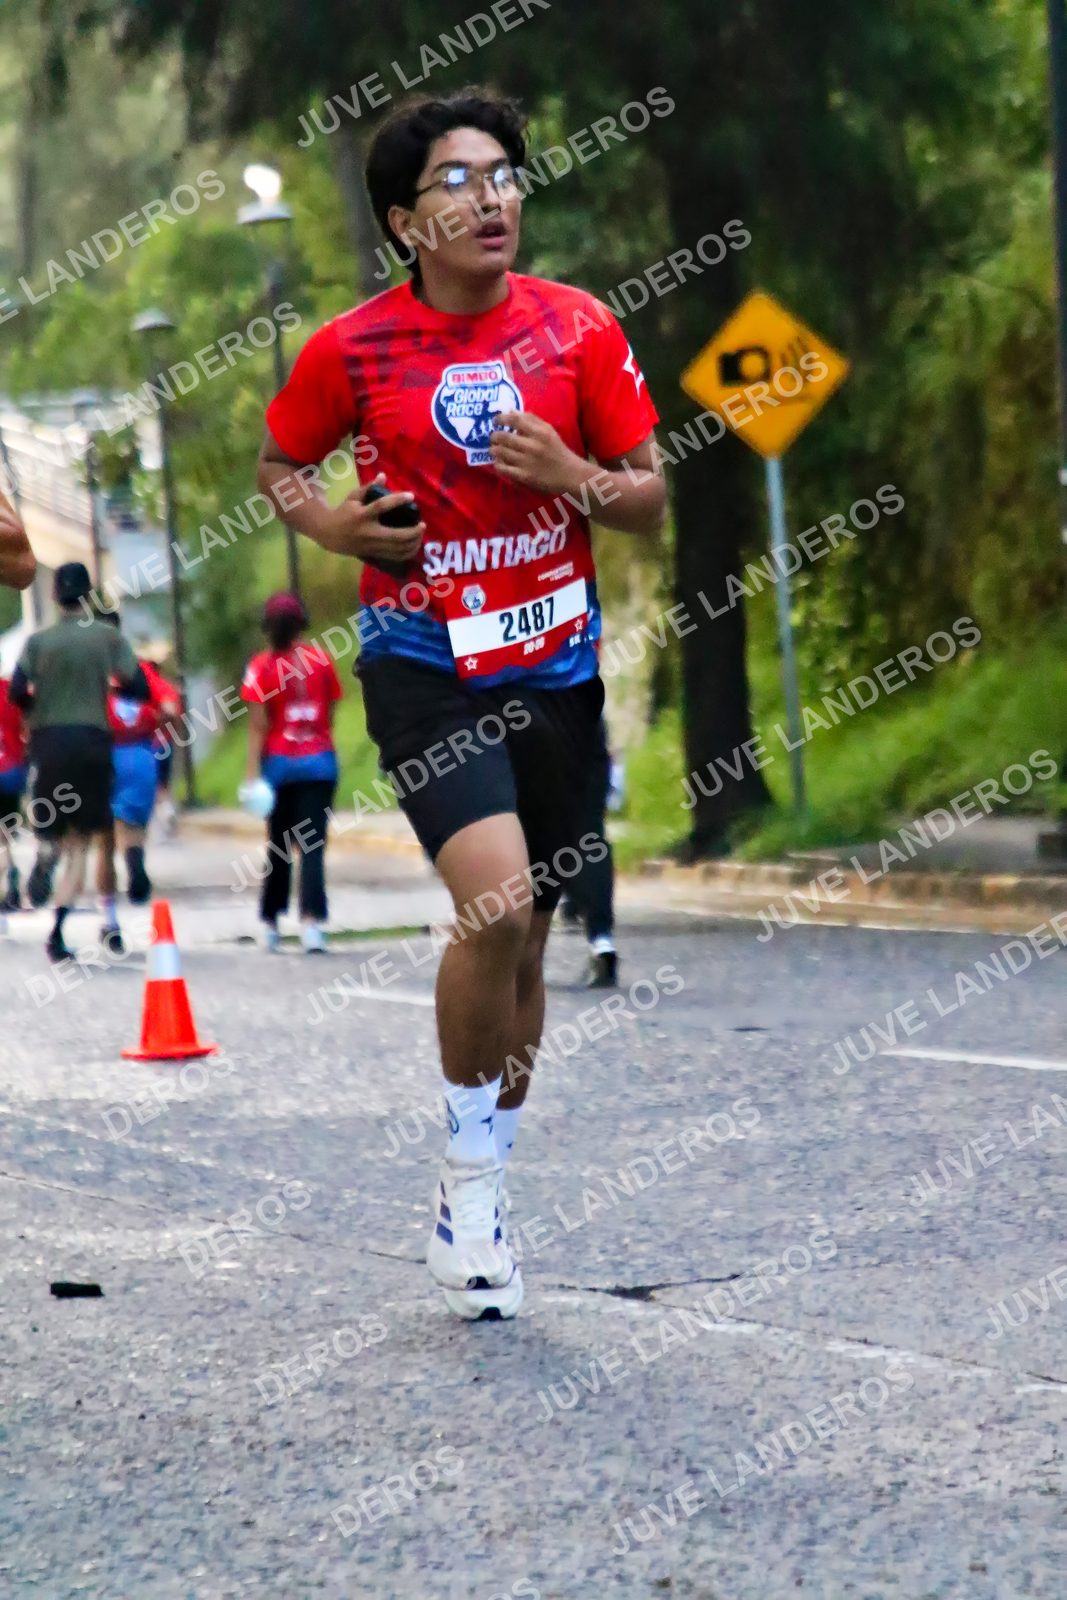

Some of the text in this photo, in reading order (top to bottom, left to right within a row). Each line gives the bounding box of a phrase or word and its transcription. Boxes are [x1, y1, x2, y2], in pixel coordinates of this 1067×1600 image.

[453, 386, 498, 403] Global
[446, 402, 484, 418] Race
[470, 451, 495, 463] 202
[422, 528, 566, 576] SANTIAGO
[499, 596, 555, 643] 2487
